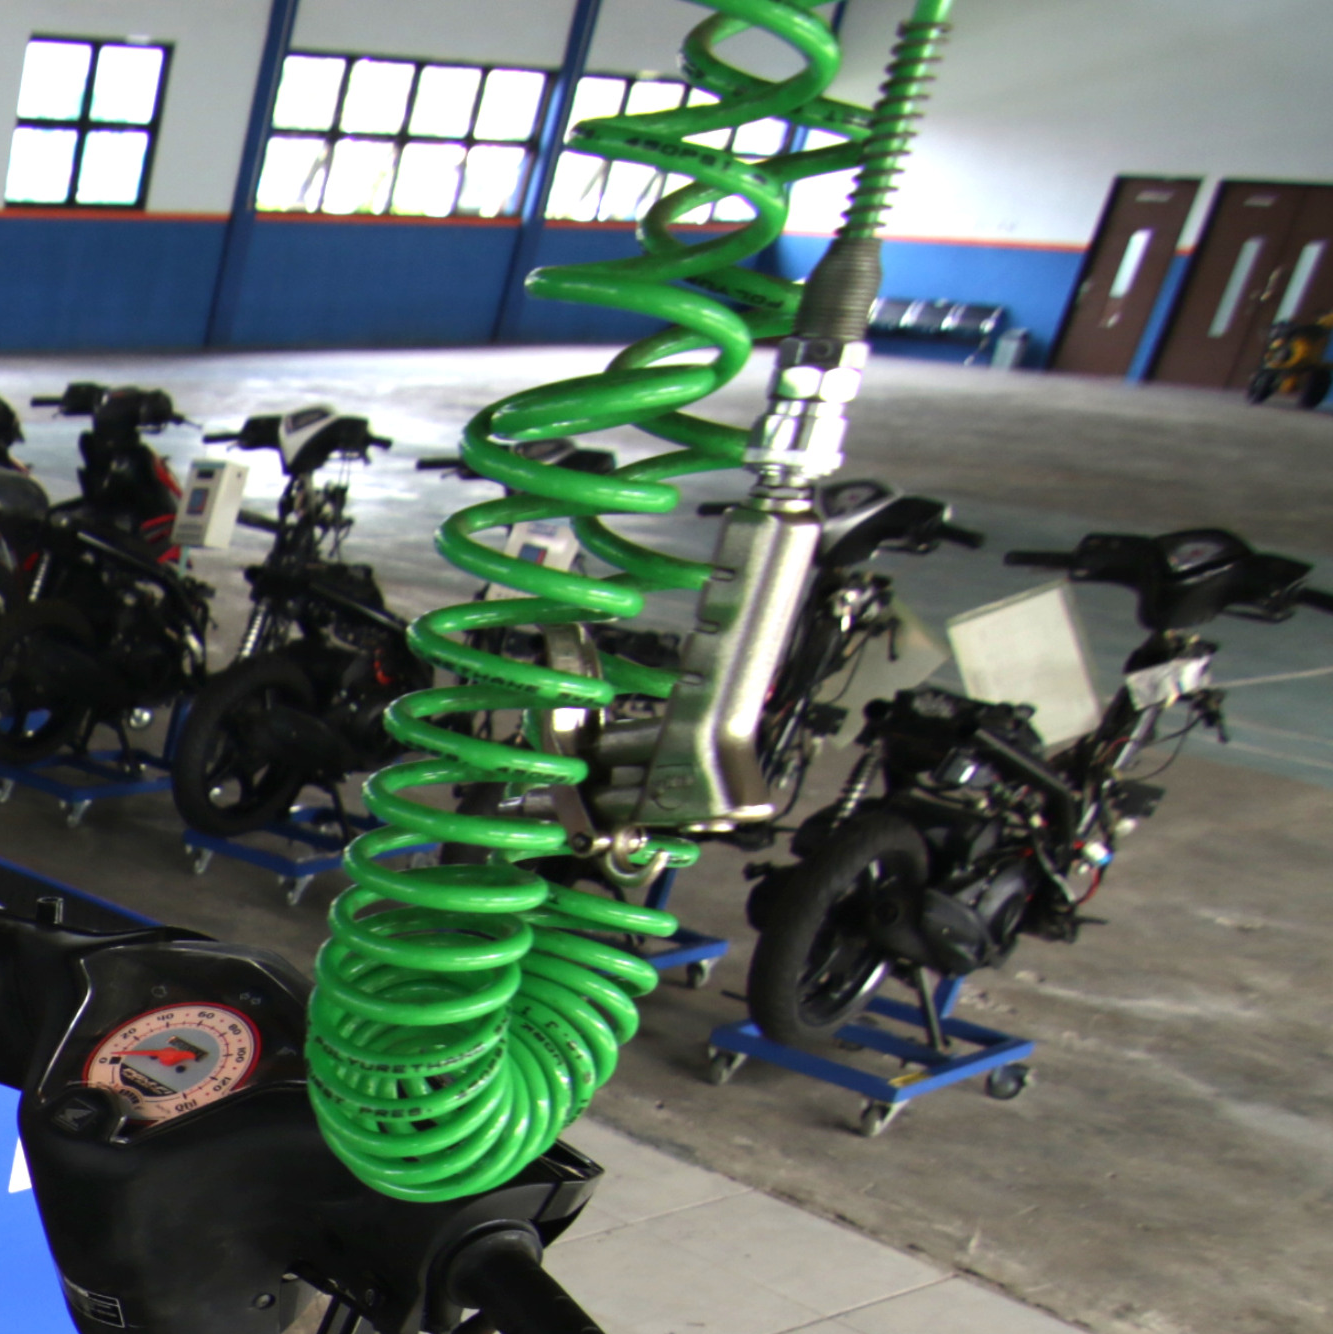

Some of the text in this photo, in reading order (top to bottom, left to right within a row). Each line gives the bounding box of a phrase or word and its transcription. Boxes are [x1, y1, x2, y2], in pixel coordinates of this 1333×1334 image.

[156, 1012, 174, 1021] 40
[197, 1010, 215, 1019] 60
[122, 1027, 137, 1040] 20
[228, 1023, 242, 1035] 80
[235, 1046, 247, 1063] 100
